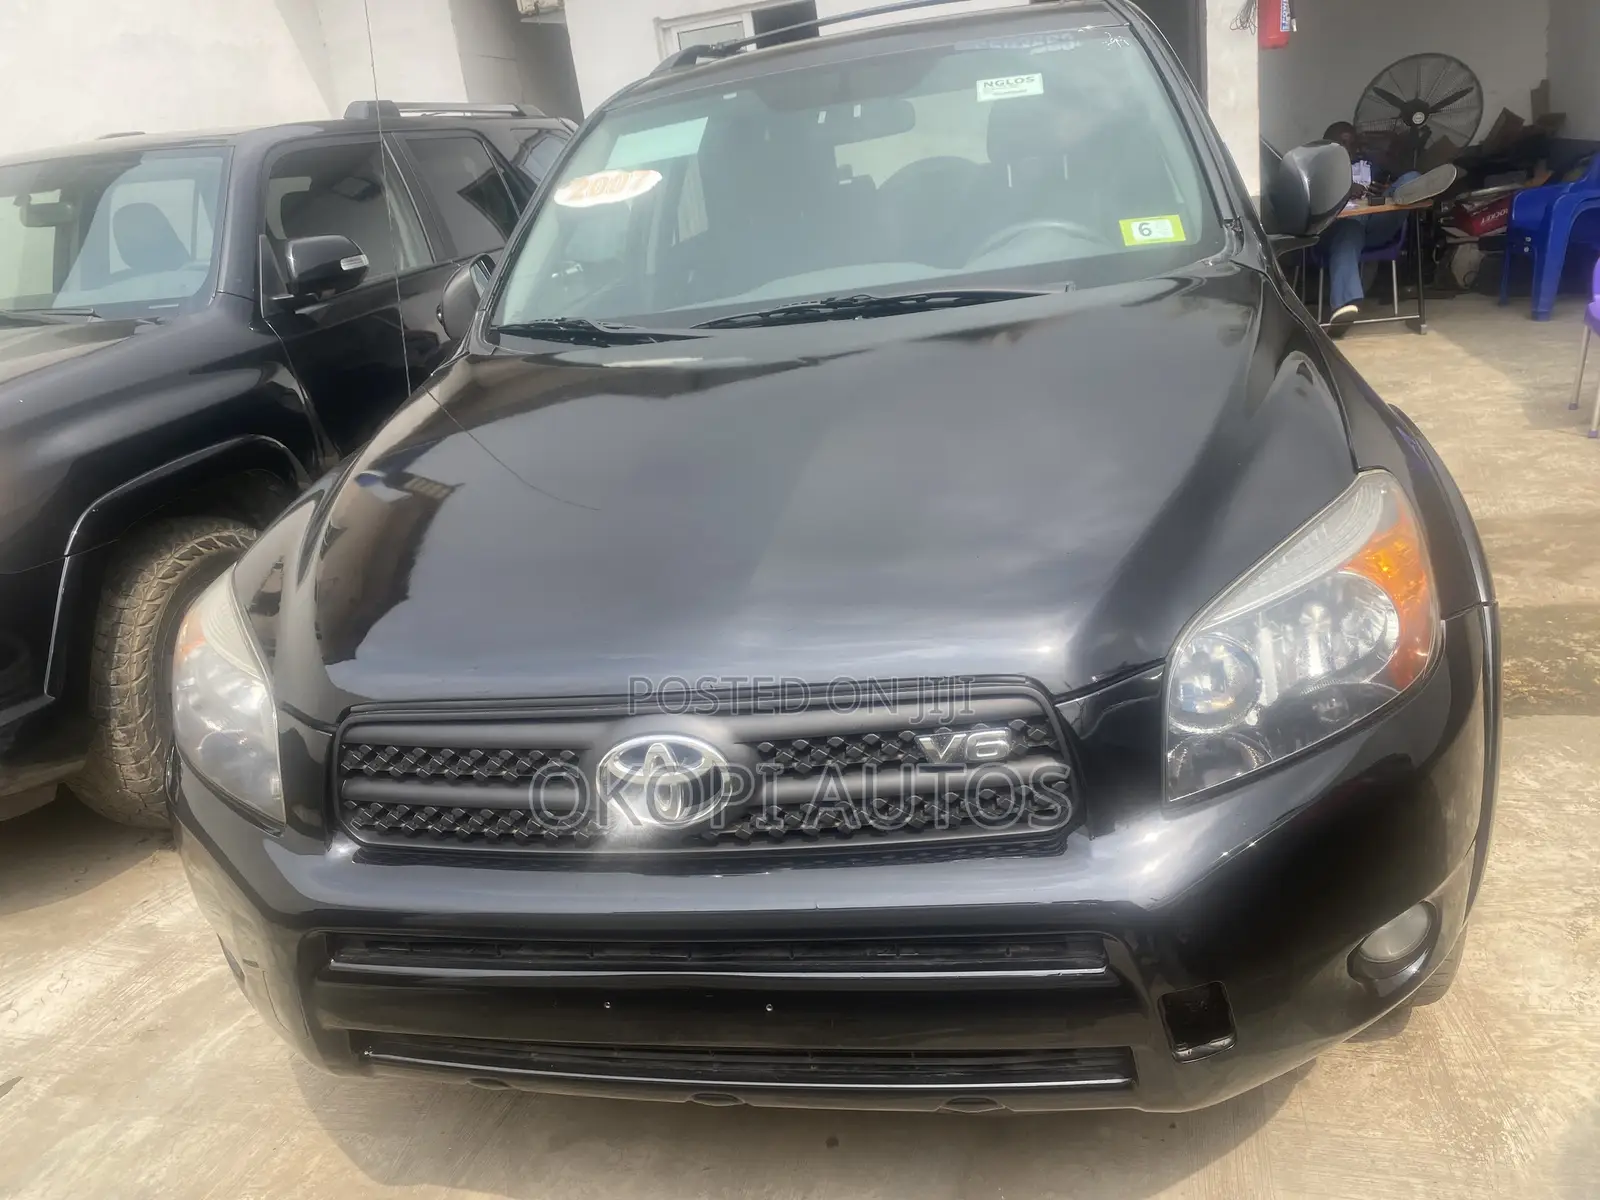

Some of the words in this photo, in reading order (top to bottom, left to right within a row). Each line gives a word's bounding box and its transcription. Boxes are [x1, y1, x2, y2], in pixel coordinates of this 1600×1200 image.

[983, 76, 1035, 88] NGLOS
[1138, 222, 1152, 237] 6
[914, 727, 1011, 763] V6
